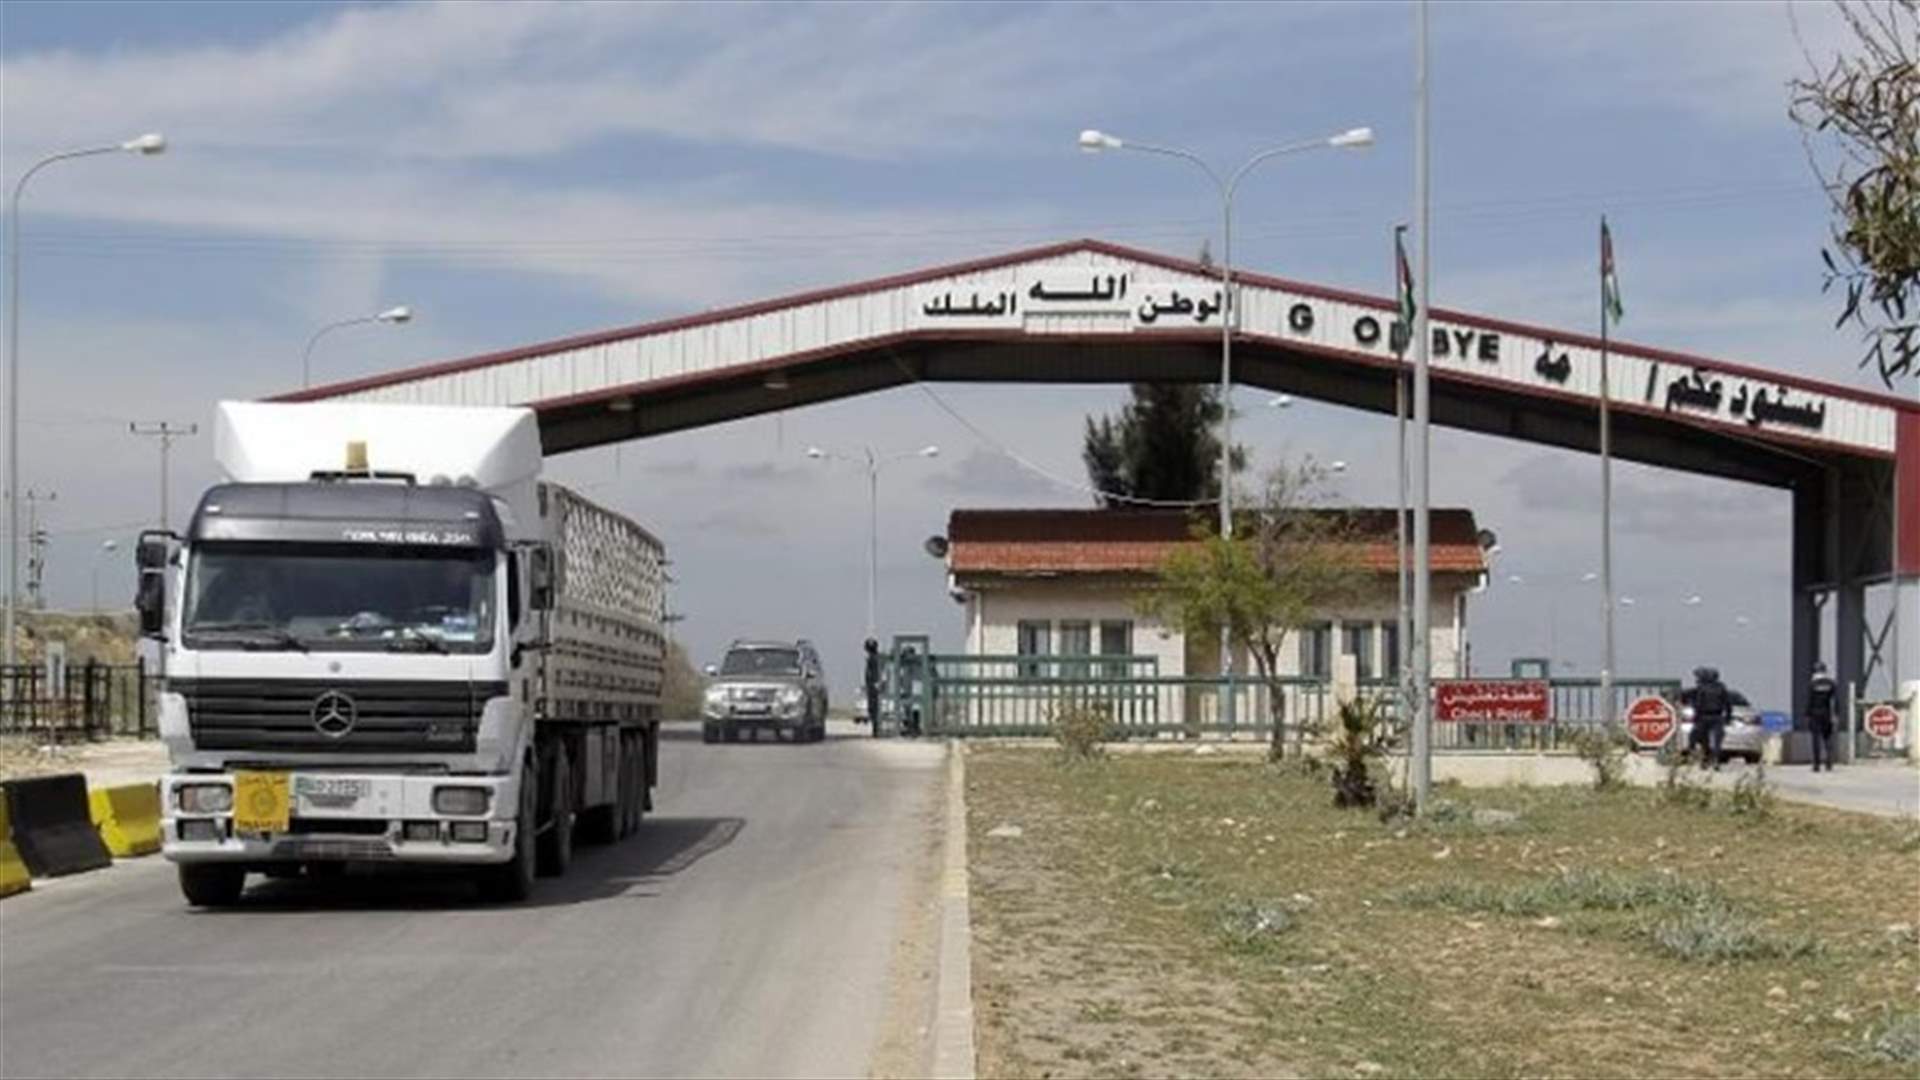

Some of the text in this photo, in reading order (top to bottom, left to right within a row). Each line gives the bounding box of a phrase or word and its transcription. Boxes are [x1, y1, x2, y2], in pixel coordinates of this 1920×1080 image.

[1028, 273, 1128, 302] الله
[923, 291, 1017, 317] الملك
[1138, 289, 1232, 323] الوطن
[1630, 721, 1670, 735] STOP
